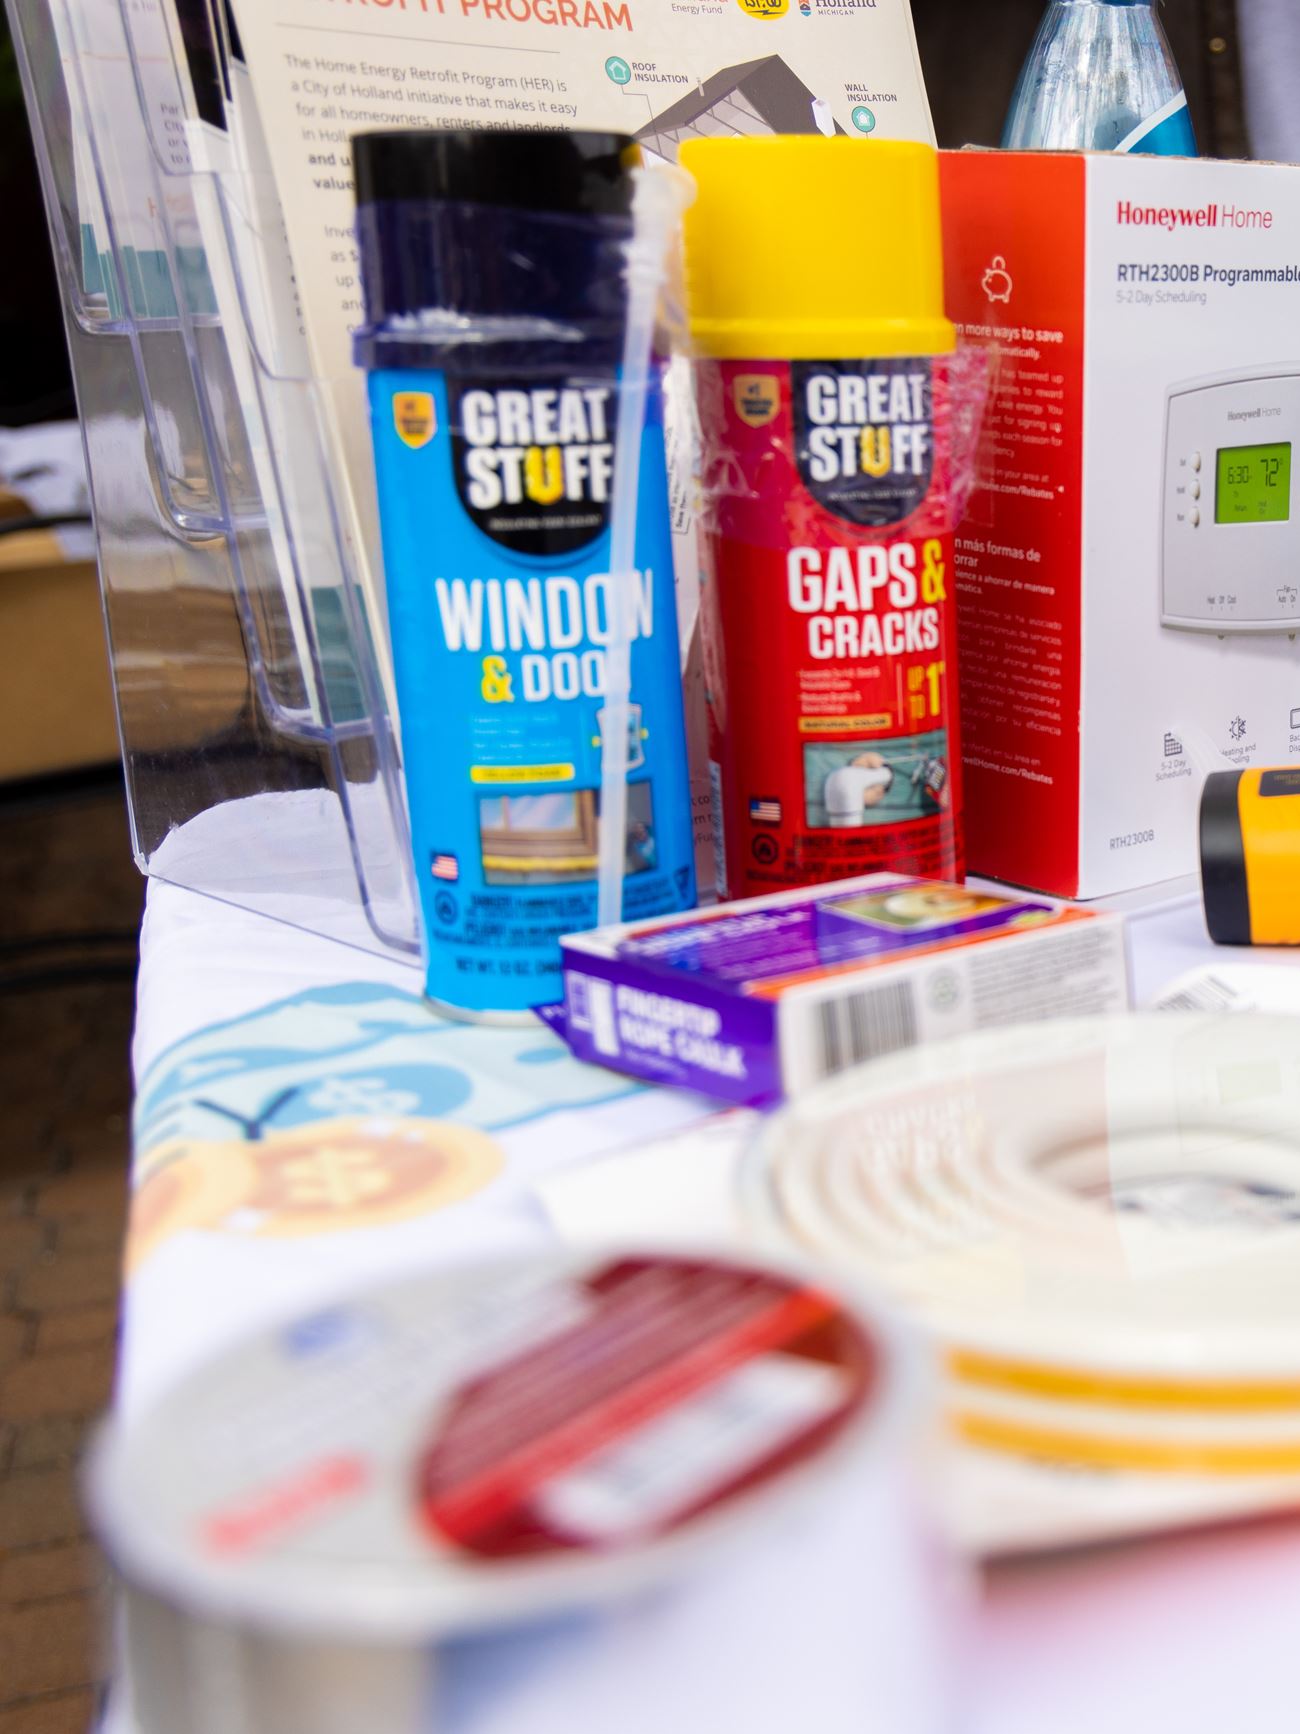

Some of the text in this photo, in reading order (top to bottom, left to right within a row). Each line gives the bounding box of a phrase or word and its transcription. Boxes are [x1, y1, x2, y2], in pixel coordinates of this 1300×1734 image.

[460, 0, 633, 32] PROGRAM
[671, 3, 722, 15] Energy Fund
[284, 54, 568, 92] The Home Energy Retrofit Program (HER) is
[632, 62, 657, 72] ROOF
[634, 72, 689, 84] INSULATION
[844, 83, 869, 92] WALL
[291, 79, 577, 117] a City of Holland initiative that makes it easy
[847, 93, 898, 102] INSULATION
[296, 102, 316, 117] for
[321, 104, 337, 119] all
[340, 107, 433, 128] homeowners,
[302, 129, 315, 141] in
[308, 154, 337, 167] and
[1116, 201, 1274, 231] Honeywell Home
[337, 276, 354, 288] up
[1117, 264, 1199, 283] RTH2300B
[1116, 290, 1207, 307] 5-2 Day Scheduling
[965, 324, 992, 337] more
[993, 327, 1021, 343] ways
[1022, 326, 1035, 340] to
[1035, 330, 1064, 343] save
[806, 374, 927, 425] GREAT
[461, 389, 609, 447] GREAT
[1227, 406, 1282, 422] Honeywell Home
[809, 425, 929, 482] STUFF
[466, 445, 614, 509] STUFF
[963, 538, 1042, 562] más formas de
[953, 553, 979, 568] orrar
[787, 538, 947, 613] GAPS &
[984, 575, 1012, 588] ahorrar
[1012, 580, 1023, 590] de
[808, 608, 940, 660] CRACKS
[481, 655, 515, 703] &
[1245, 743, 1257, 752] and
[1173, 758, 1187, 769] Day
[1155, 767, 1192, 781] Scheduling
[1109, 829, 1156, 850] RTH2300B
